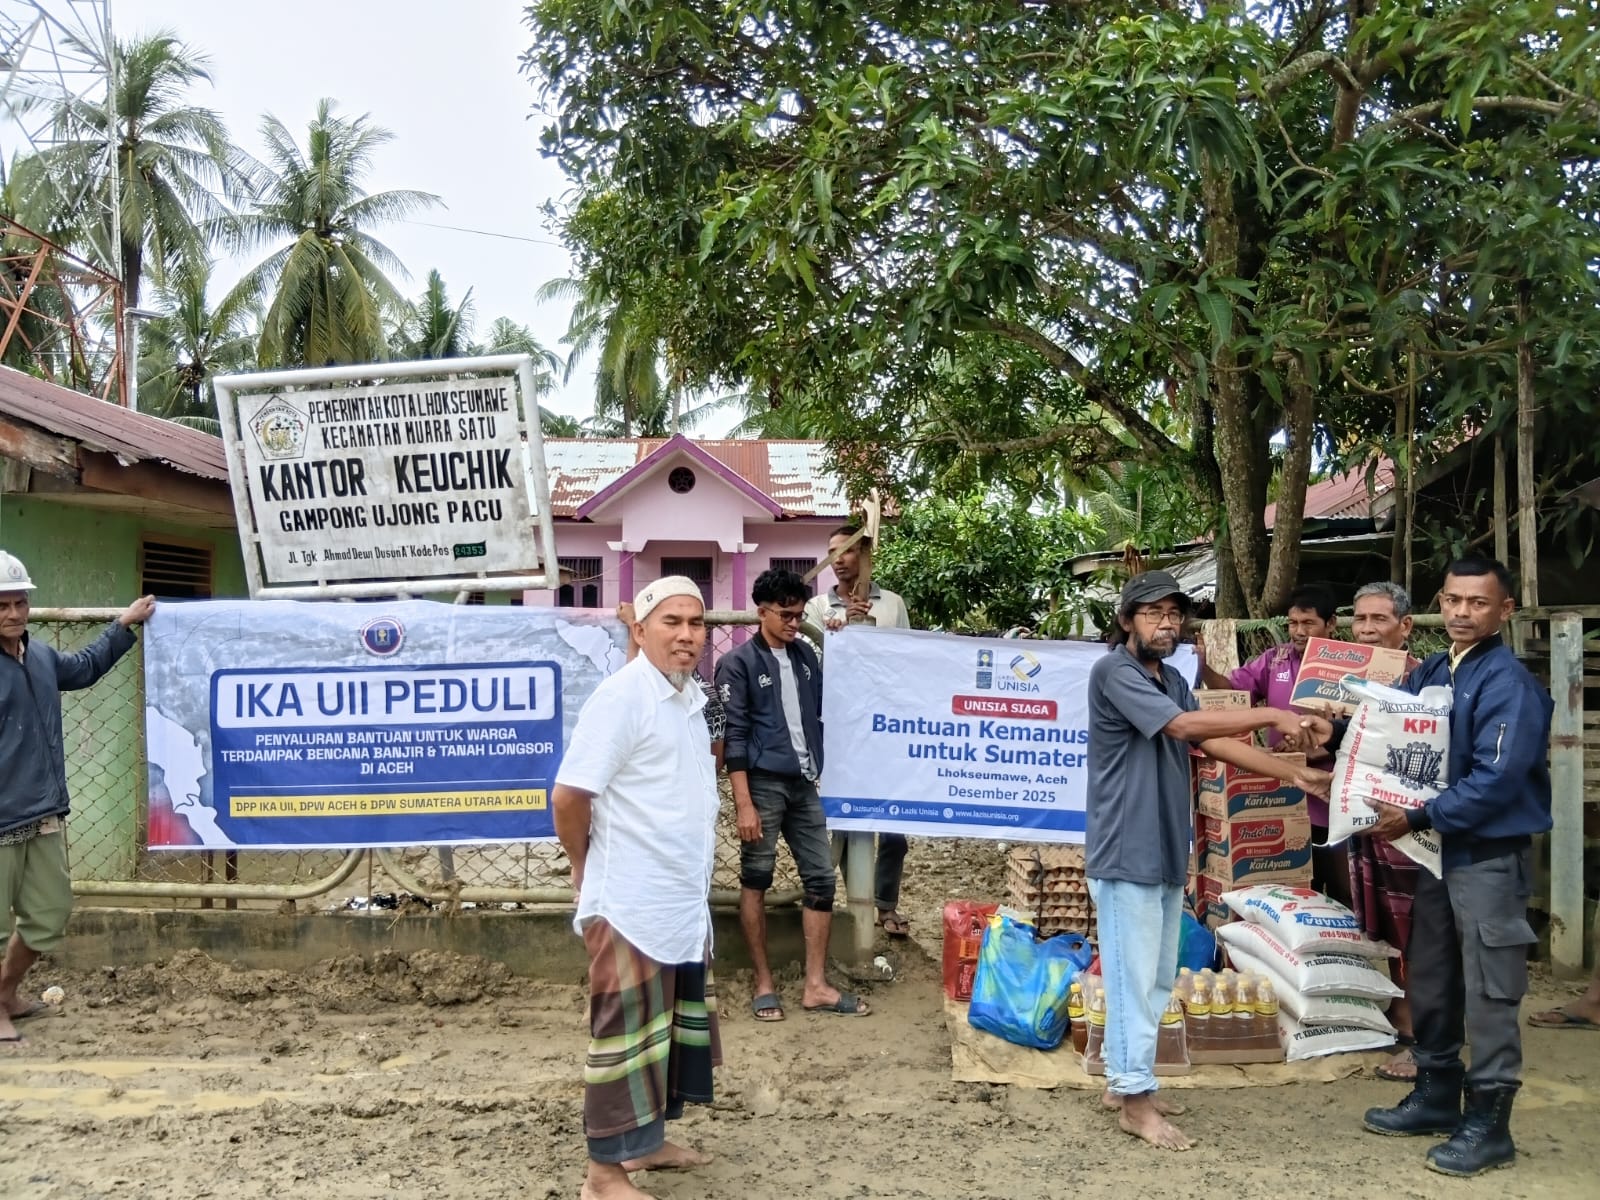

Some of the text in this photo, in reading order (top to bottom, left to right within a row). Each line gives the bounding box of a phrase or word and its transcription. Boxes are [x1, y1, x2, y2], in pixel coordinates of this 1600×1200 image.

[309, 388, 509, 424] PEMERINTAH KOTA LHOKSEUMAWE
[322, 416, 496, 449] KECAMATAN MUARA SATU
[260, 449, 514, 501] KANTOR KEUCHIK
[280, 499, 503, 532] GAMPONG UJONG PACU
[374, 546, 400, 559] Dusun
[410, 545, 432, 557] Kode
[433, 544, 450, 556] Pos
[998, 680, 1040, 692] UNISIA
[1315, 684, 1338, 697] Kari
[236, 676, 537, 718] IKA UII PEDULI
[963, 700, 1049, 716] UNISIA SIAGA
[872, 713, 1088, 744] Bantuan Kemanus
[1403, 718, 1437, 734] KPI
[255, 727, 517, 746] PENYALURAN BANTUAN UNTUK WARGA
[221, 742, 554, 762] TERDAMPAK BENCANA BANJIR & TANAH LONGSOR
[908, 742, 1087, 767] untuk Sumater
[360, 762, 414, 775] DI ACEH
[937, 768, 1068, 785] Lhokseumawe, Aceh
[948, 785, 1056, 803] Desember 2025
[1244, 796, 1286, 808] Kari Ayam
[1371, 787, 1425, 809] PINTU AC
[236, 795, 540, 813] DPP IKA UII, DPW ACEH & DPW SUMATERA UTARA IKA UII
[919, 808, 938, 816] Unisia
[955, 810, 1019, 822] www.lazisunisia.org
[1249, 860, 1291, 871] Kari Ayam
[1260, 902, 1281, 924] SPECIAL
